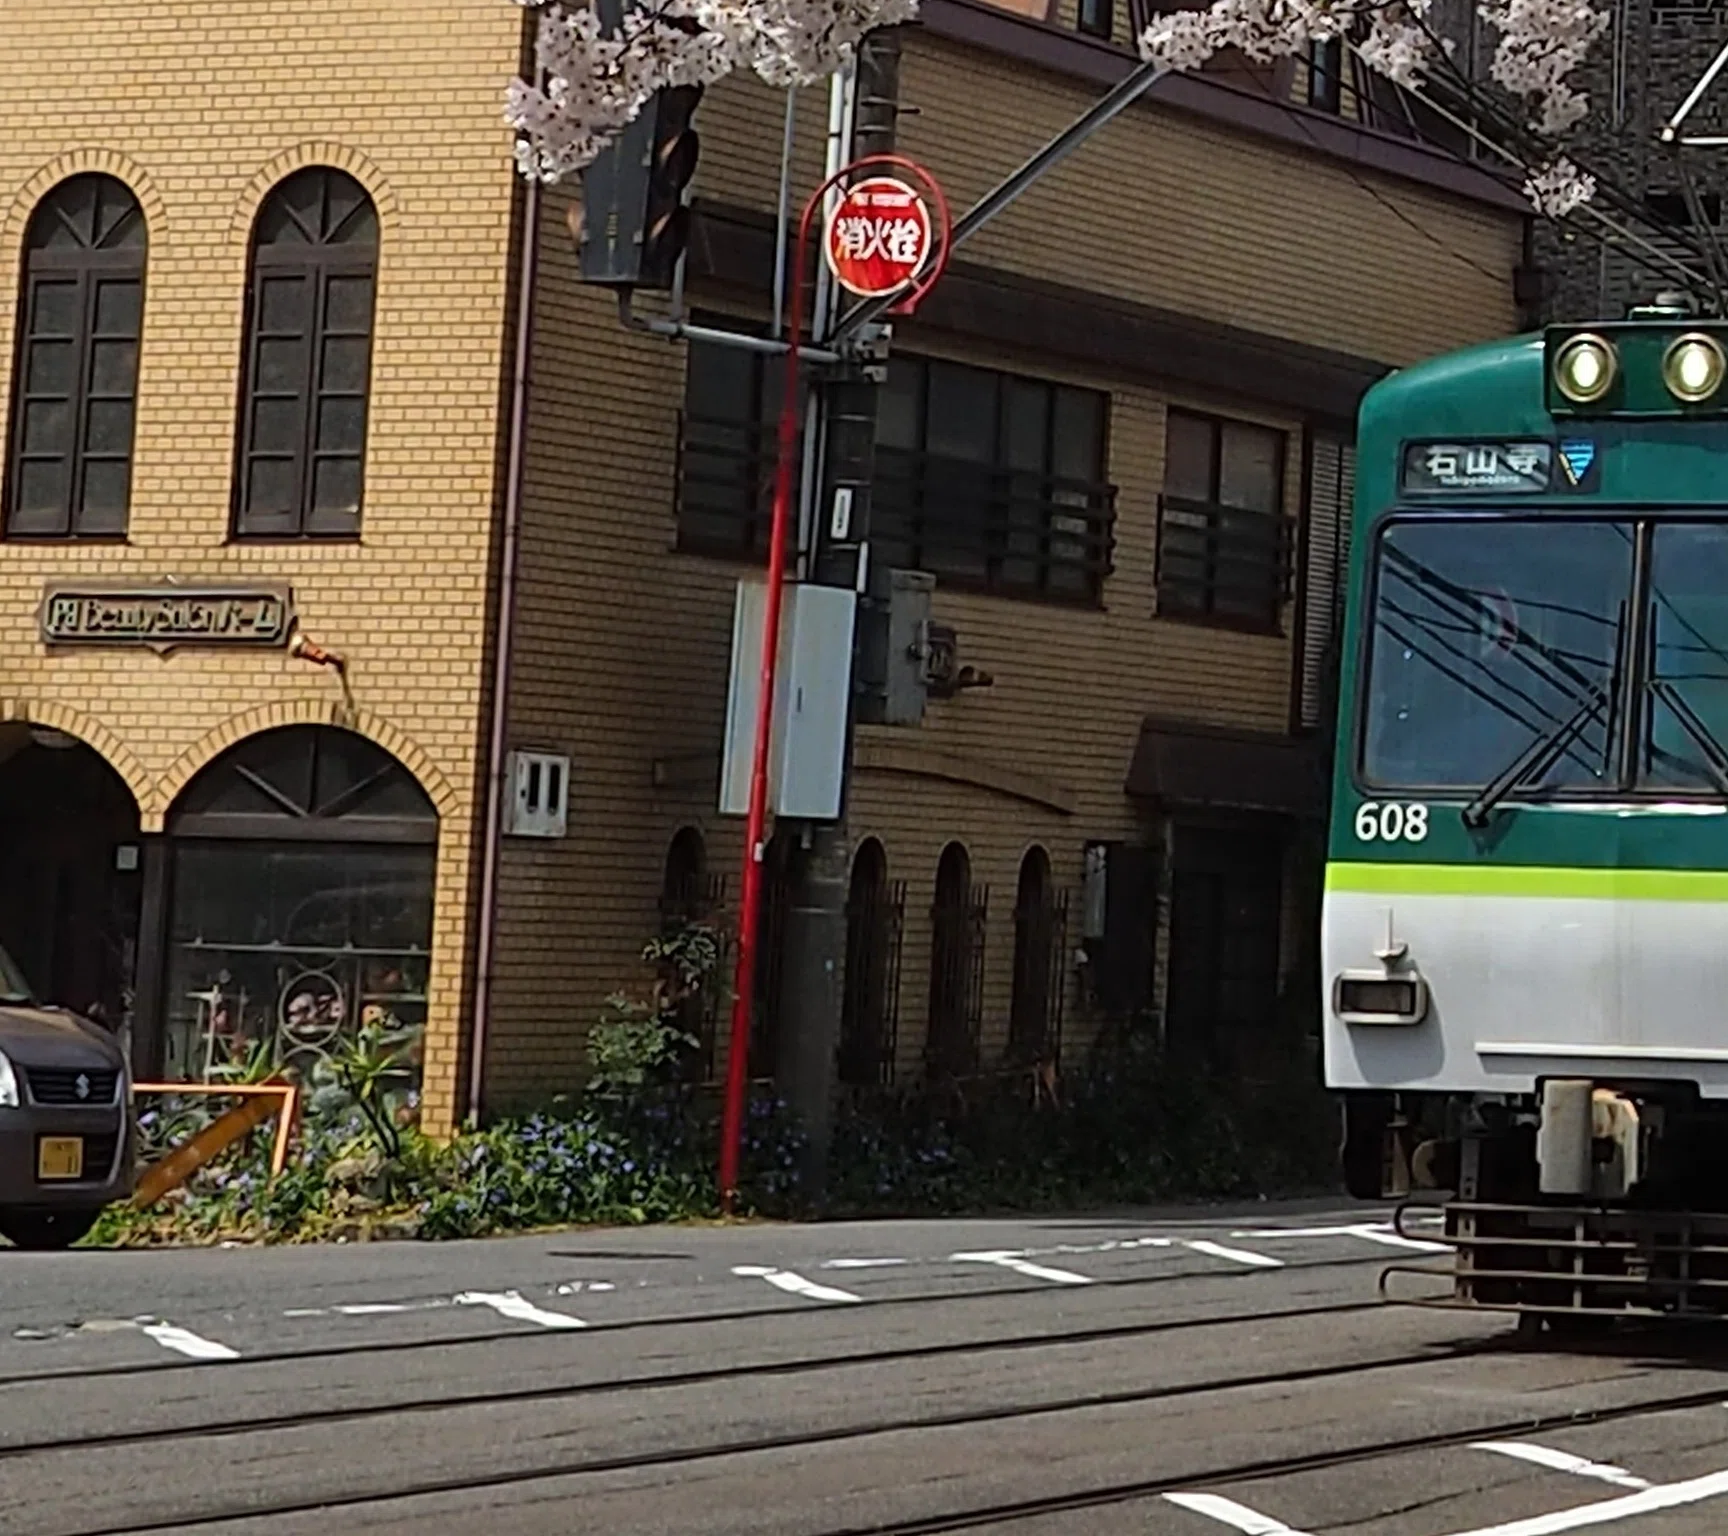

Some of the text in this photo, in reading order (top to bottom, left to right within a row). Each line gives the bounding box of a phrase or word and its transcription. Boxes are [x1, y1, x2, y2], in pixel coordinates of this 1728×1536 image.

[835, 216, 921, 263] 消火栓
[1426, 445, 1539, 476] 石山寺
[1355, 802, 1428, 841] 608
